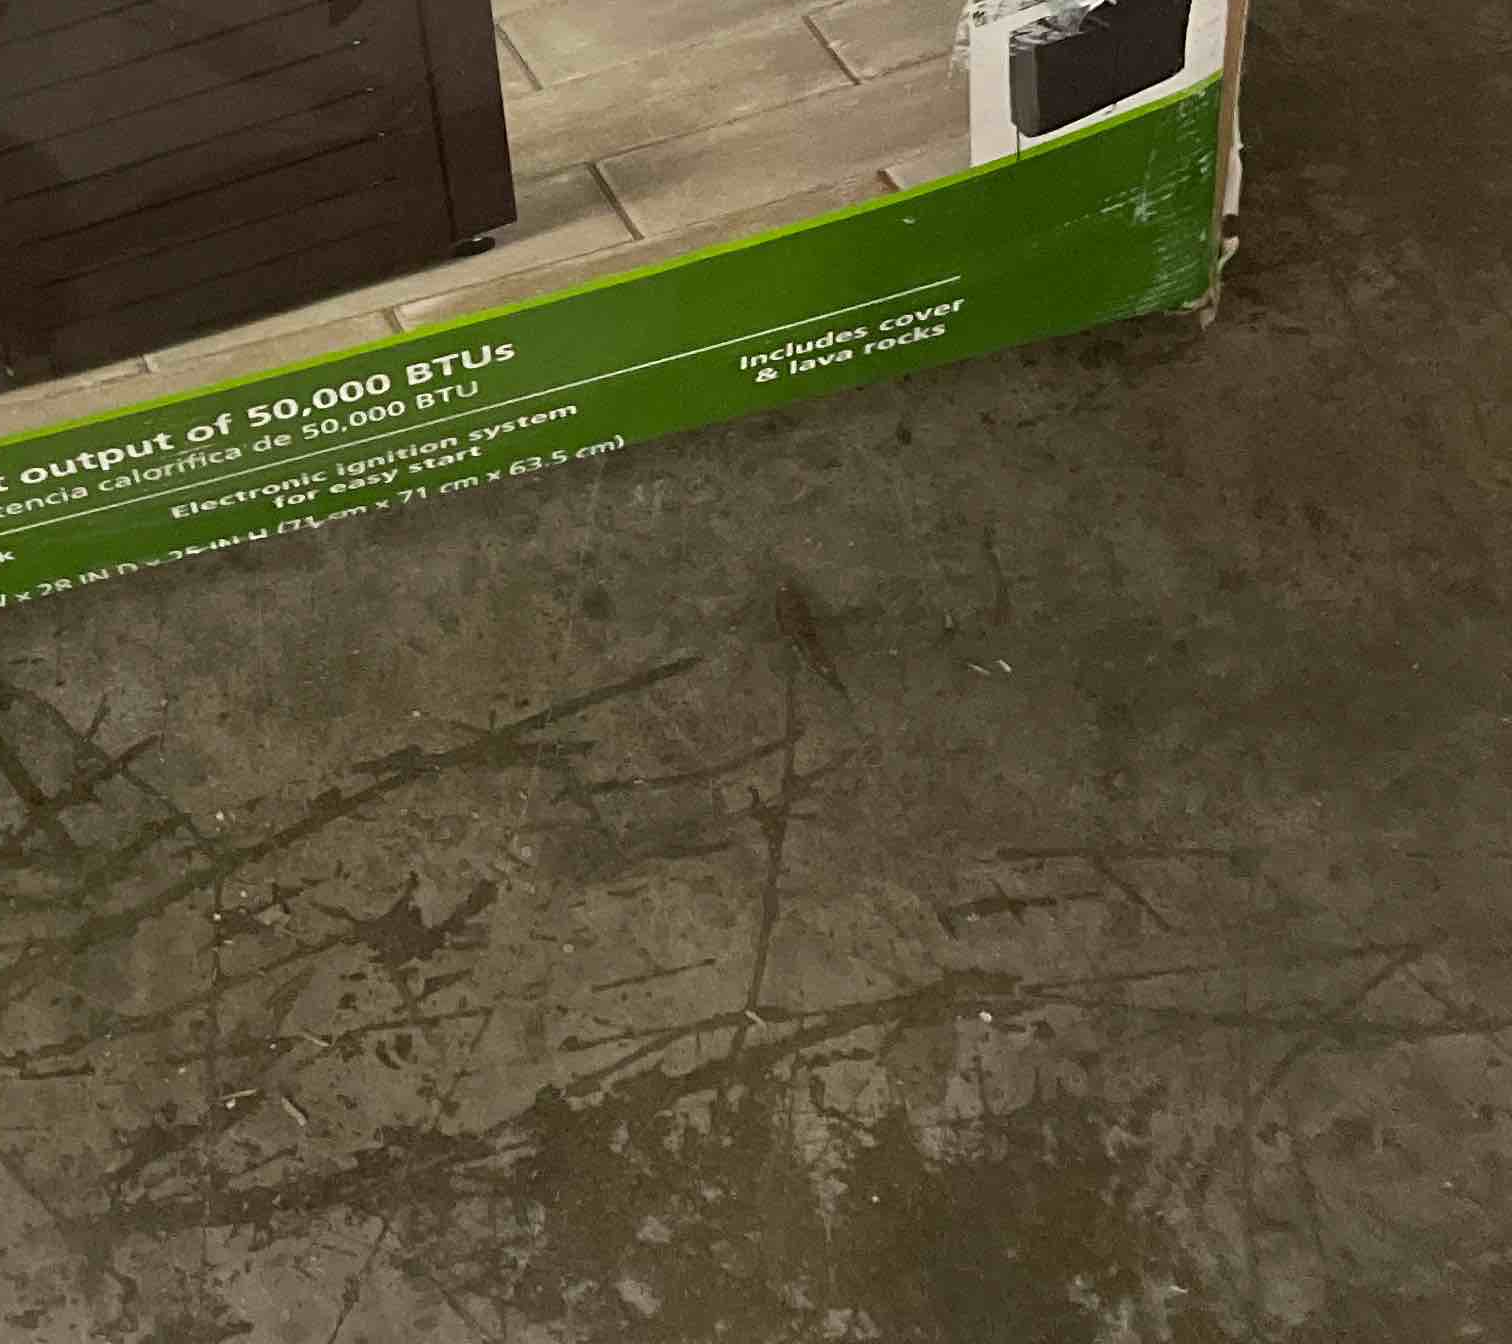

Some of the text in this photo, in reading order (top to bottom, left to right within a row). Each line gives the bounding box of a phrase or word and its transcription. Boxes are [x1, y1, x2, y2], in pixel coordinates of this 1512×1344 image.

[739, 297, 966, 370] Includes cover
[755, 322, 946, 383] & lava rocks
[20, 431, 175, 485] output
[187, 413, 233, 443] of
[246, 372, 391, 428] 50,000
[406, 342, 517, 386] BTUs
[252, 431, 293, 454] de
[415, 380, 480, 411] BTU
[170, 403, 578, 520] Electronic ignition system
[271, 446, 482, 512] for easy start
[15, 589, 33, 603] x
[79, 567, 110, 585] IN
[374, 498, 390, 512] x
[398, 486, 428, 504] 71
[439, 474, 480, 495] cm
[486, 468, 502, 481] x
[508, 449, 568, 477] 63.5
[574, 434, 625, 461] cm)
